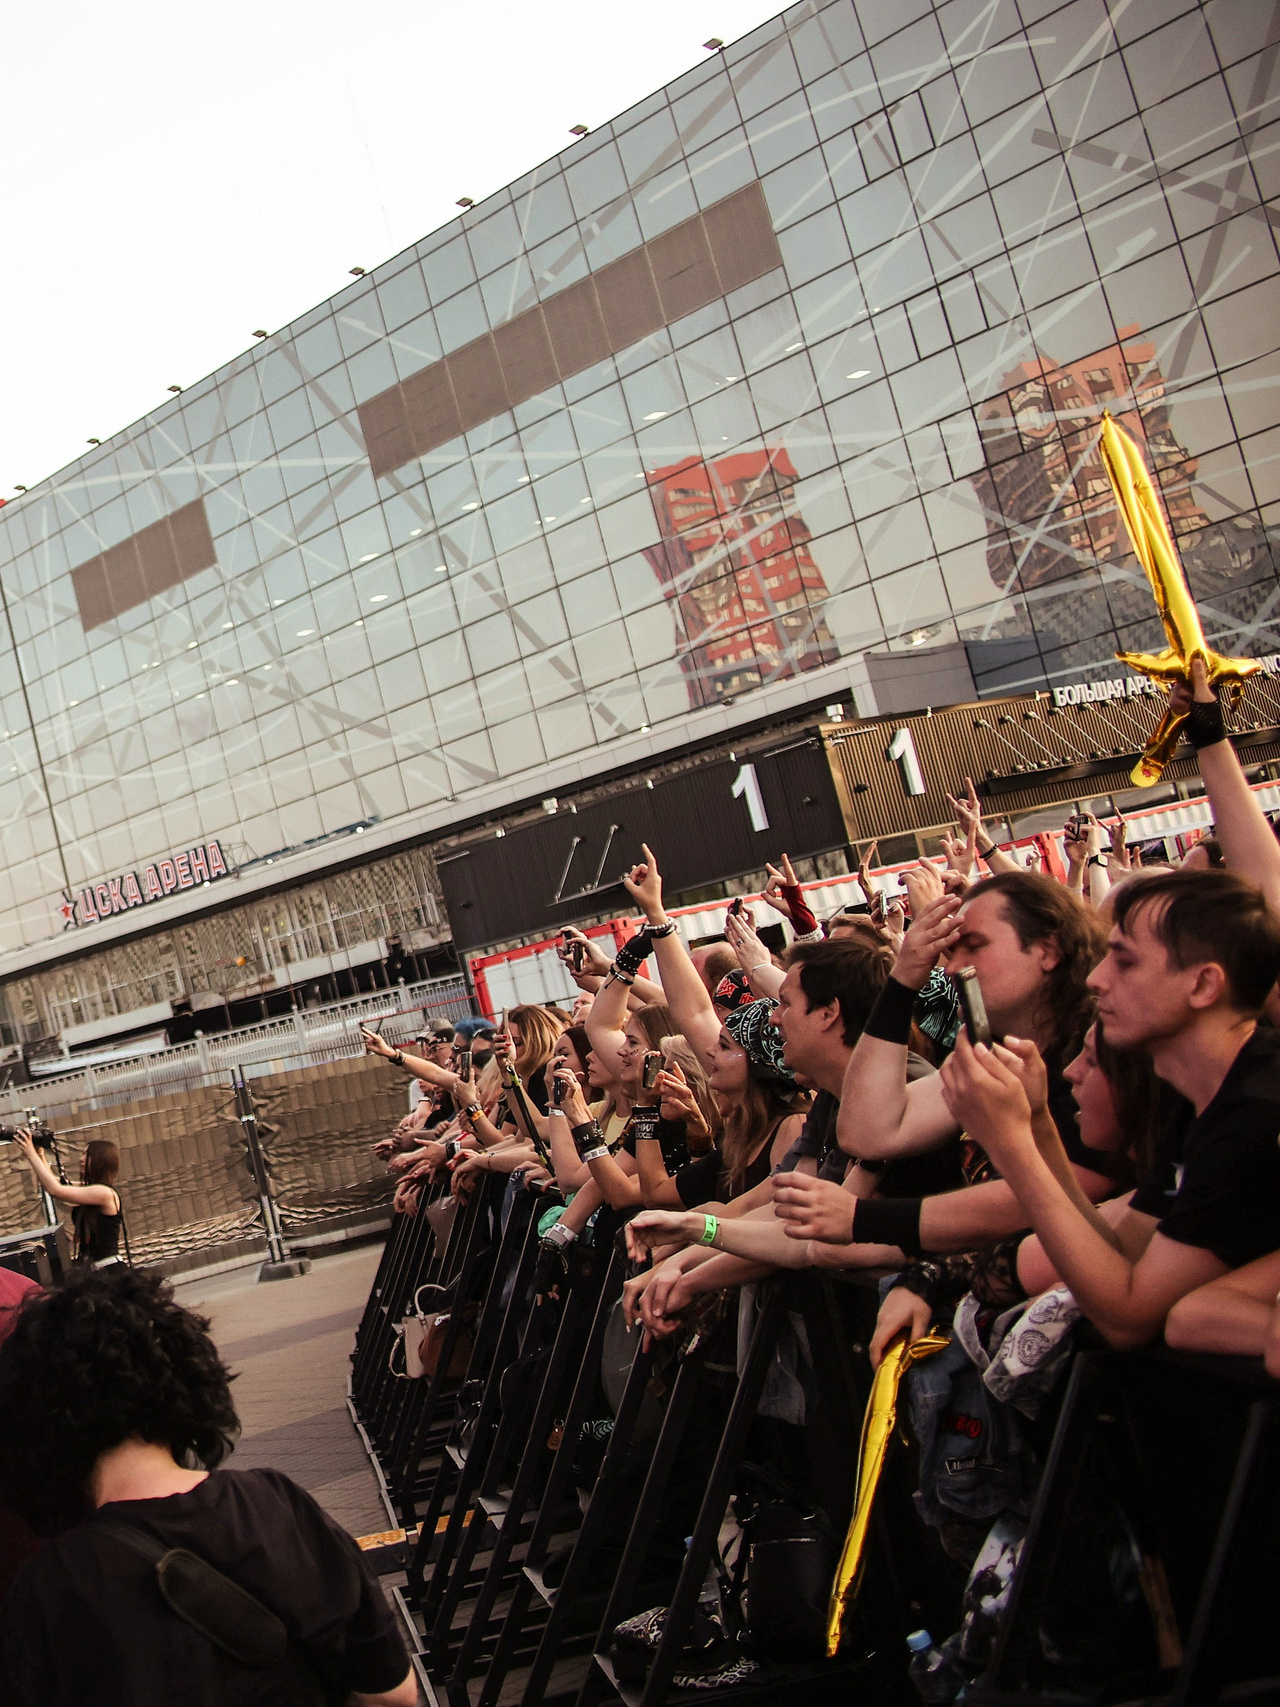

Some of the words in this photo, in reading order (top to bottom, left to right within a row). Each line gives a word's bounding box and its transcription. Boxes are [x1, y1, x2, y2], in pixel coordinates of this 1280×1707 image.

[1053, 679, 1126, 707] БОЛЬШАЯ
[1126, 675, 1174, 696] АРЕ
[889, 727, 926, 796] 1
[731, 763, 770, 833] 1
[78, 872, 143, 923] ЦСКА
[145, 841, 227, 900] АРЕНА
